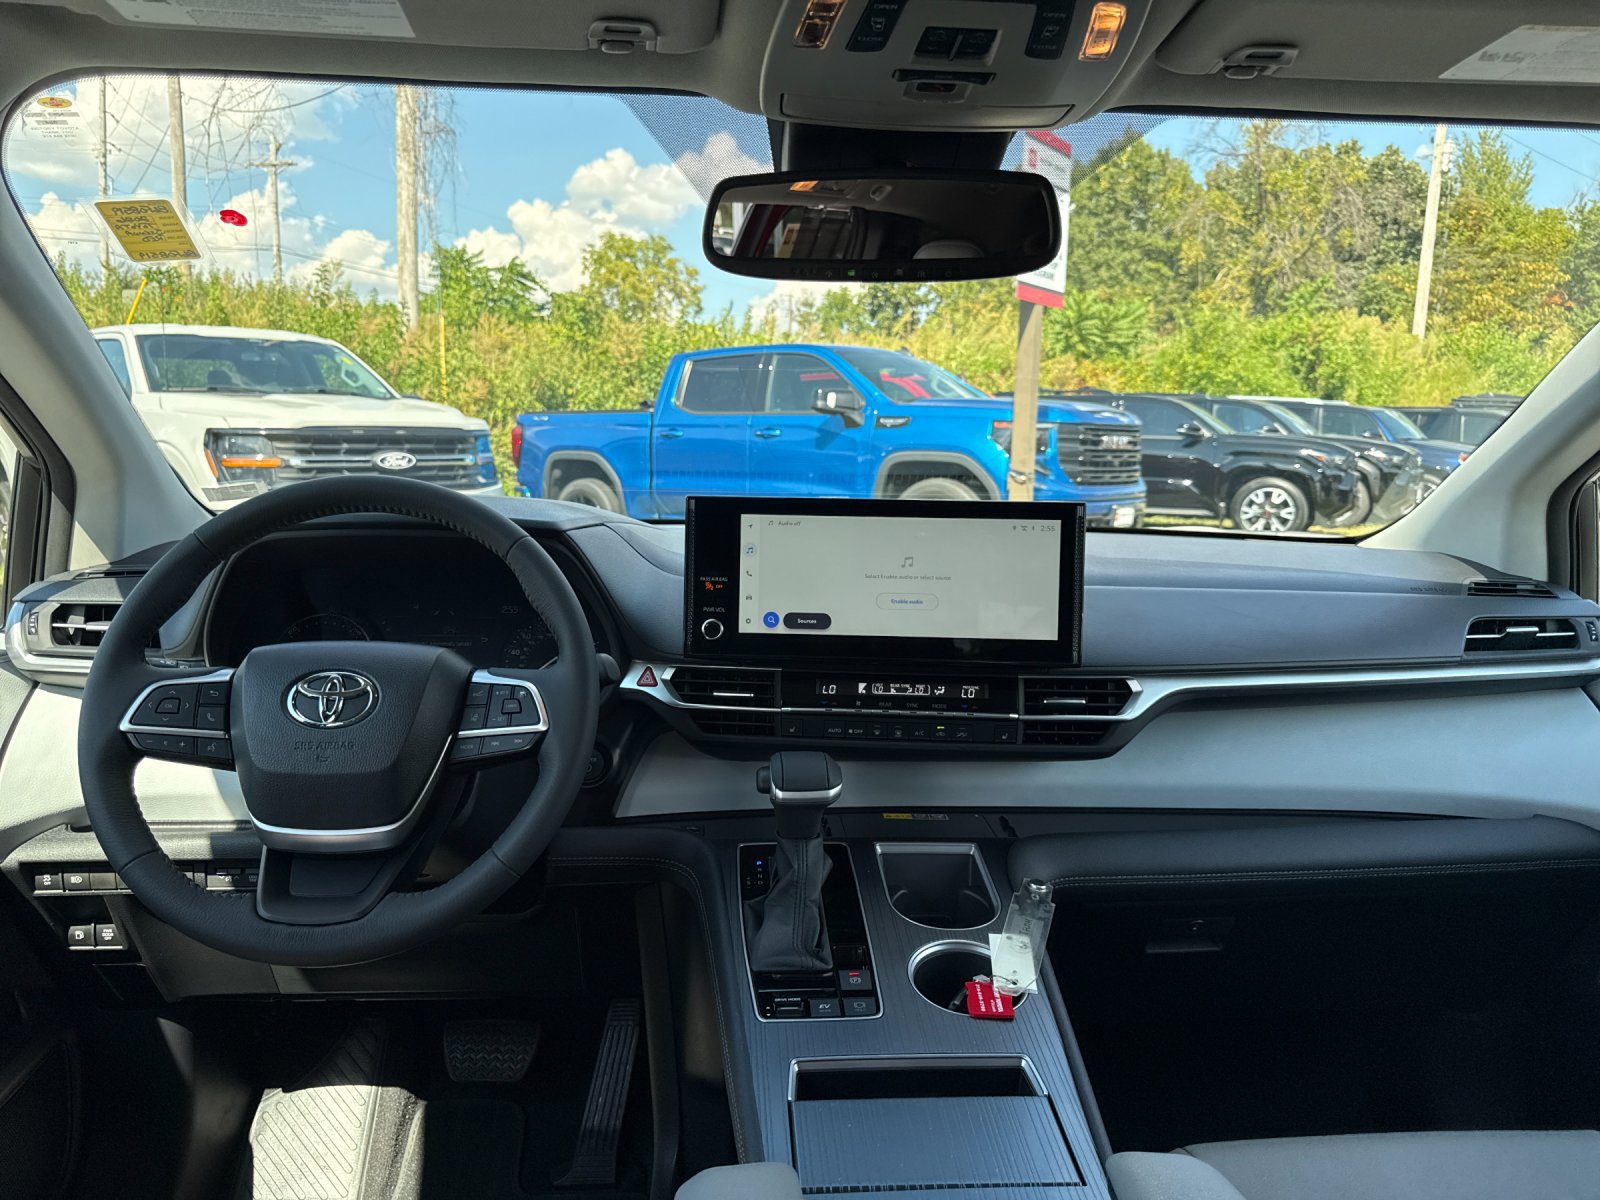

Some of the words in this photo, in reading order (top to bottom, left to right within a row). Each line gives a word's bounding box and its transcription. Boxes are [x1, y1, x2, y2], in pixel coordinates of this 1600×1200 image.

[381, 455, 410, 468] Ford
[1040, 524, 1056, 532] 2:55
[797, 617, 817, 625] Sources
